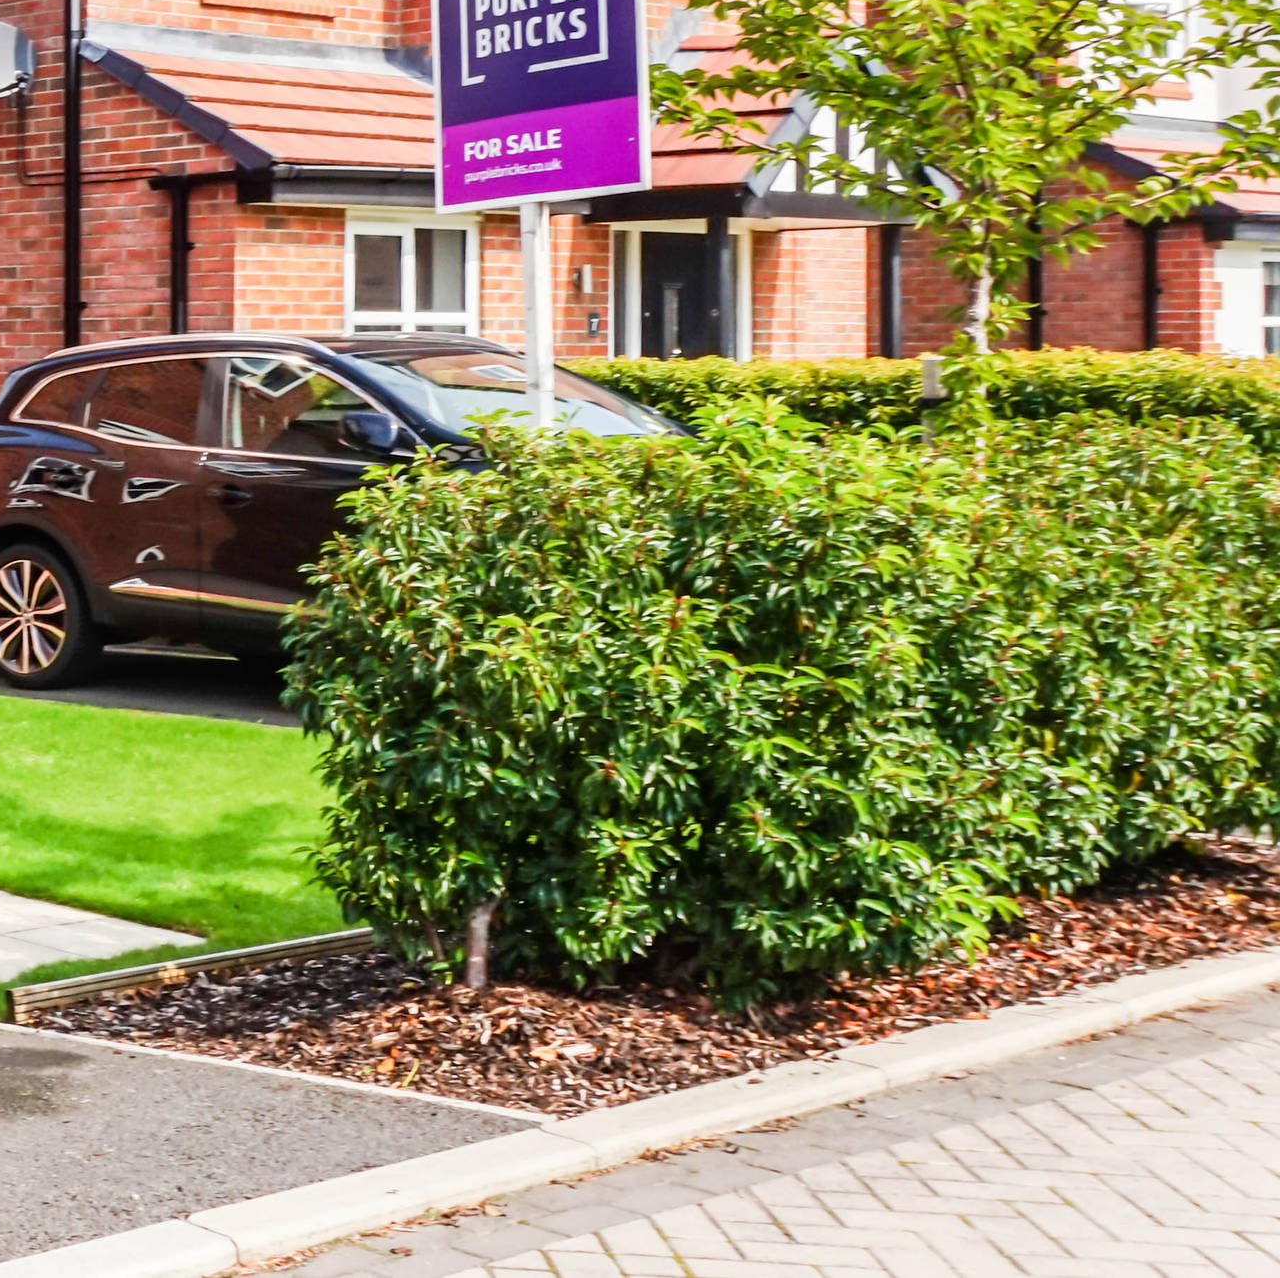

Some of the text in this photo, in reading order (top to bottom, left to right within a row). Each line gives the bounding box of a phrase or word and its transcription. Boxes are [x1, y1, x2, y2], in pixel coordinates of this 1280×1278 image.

[475, 7, 588, 59] BRICKS
[463, 128, 563, 162] FOR SALE
[463, 158, 563, 185] purplebricks.co.uk
